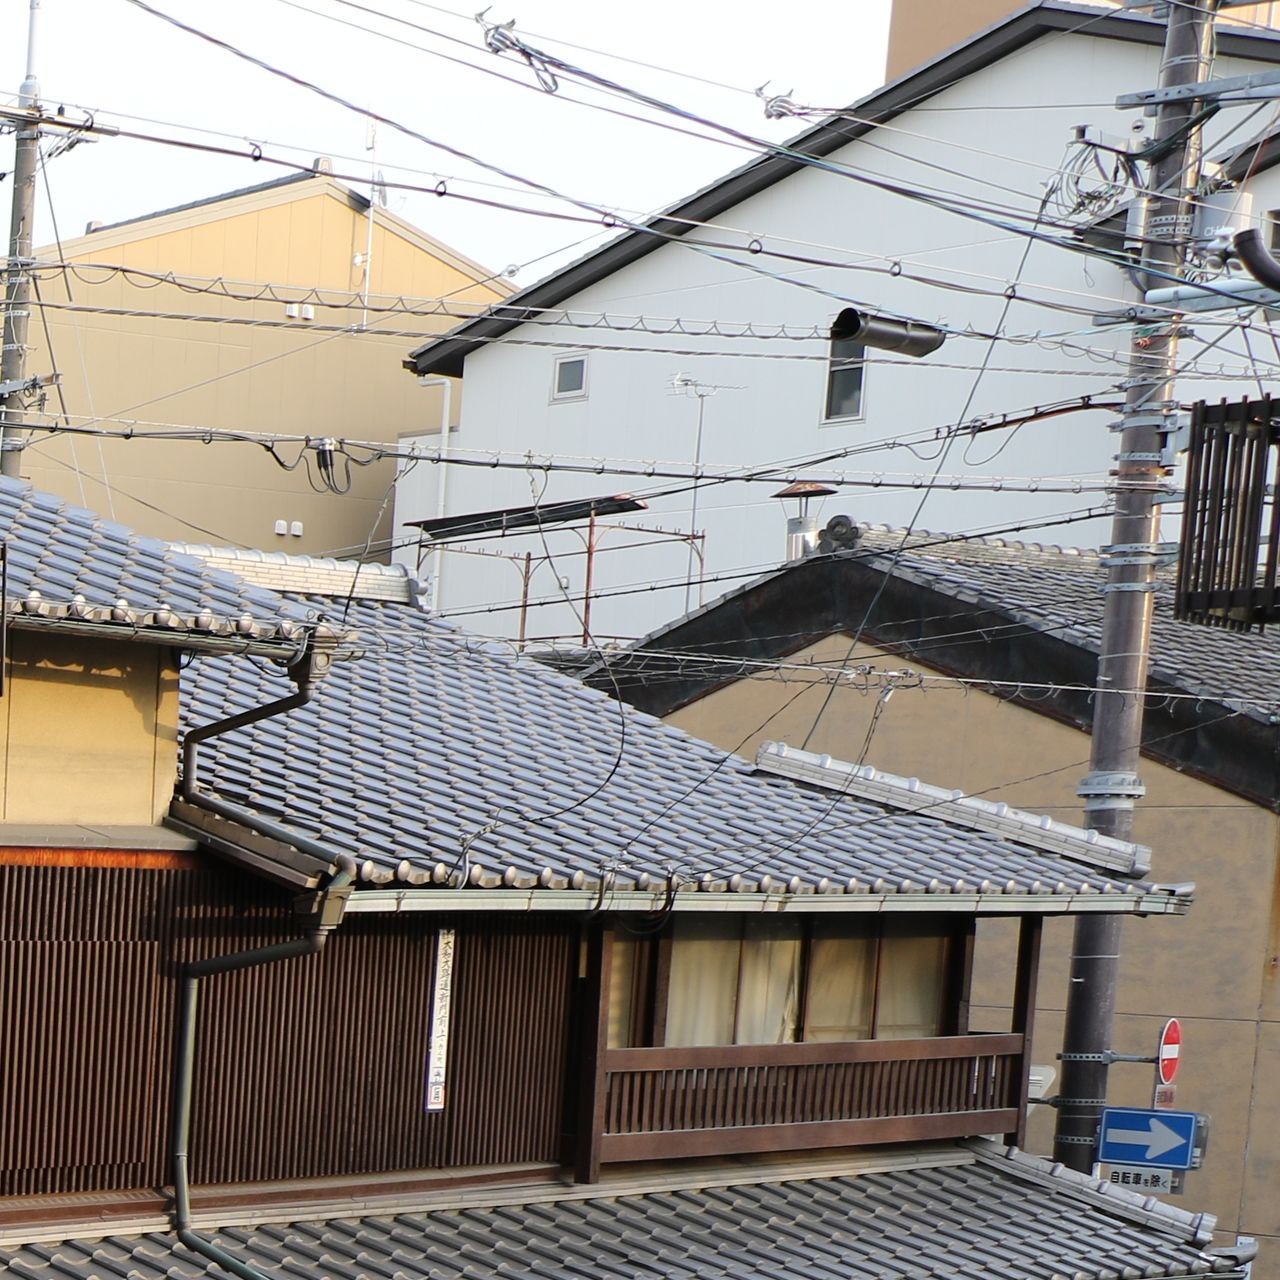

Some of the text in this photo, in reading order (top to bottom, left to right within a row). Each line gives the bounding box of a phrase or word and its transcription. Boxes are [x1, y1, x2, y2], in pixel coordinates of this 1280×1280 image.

[1111, 1170, 1168, 1188] 自転車を除く
